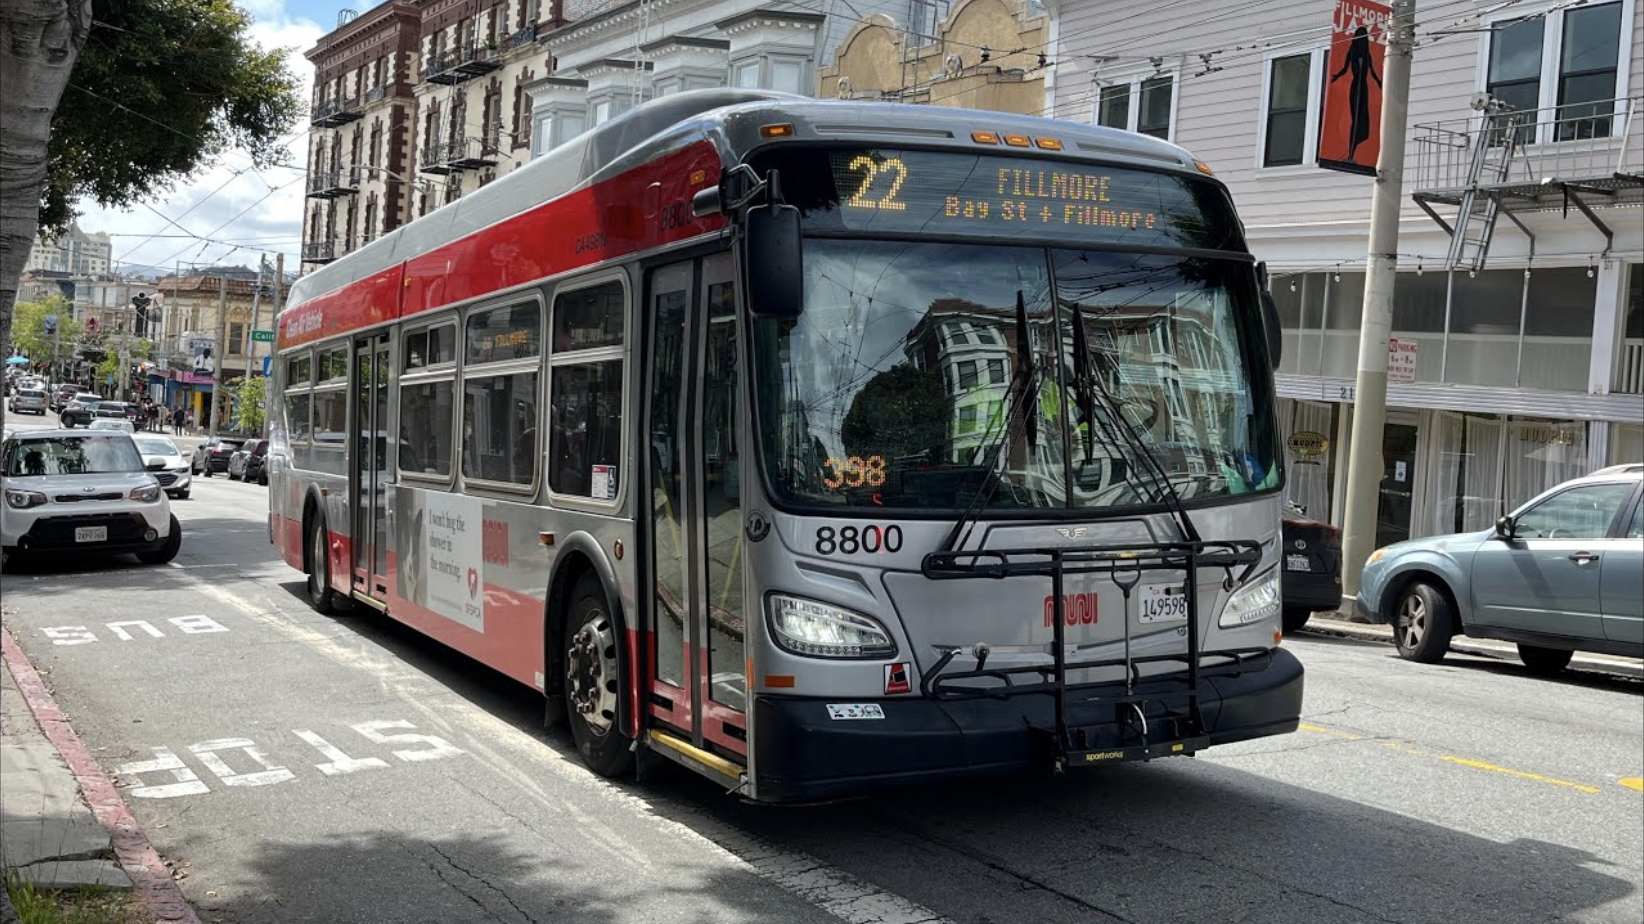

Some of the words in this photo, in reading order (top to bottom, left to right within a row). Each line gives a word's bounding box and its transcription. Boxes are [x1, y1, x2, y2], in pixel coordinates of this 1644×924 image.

[849, 156, 907, 210] 22
[998, 168, 1111, 202] FILLMORE
[946, 196, 989, 219] Bay
[1001, 200, 1027, 222] St
[1064, 204, 1156, 229] Fillmore
[823, 455, 886, 489] 398
[429, 508, 432, 525] I
[456, 514, 466, 533] the
[815, 524, 904, 556] 8800
[430, 553, 438, 571] the
[1143, 596, 1186, 618] 149598
[38, 614, 231, 646] BUS
[116, 719, 467, 799] STOP
[1086, 750, 1124, 761] sportworks
